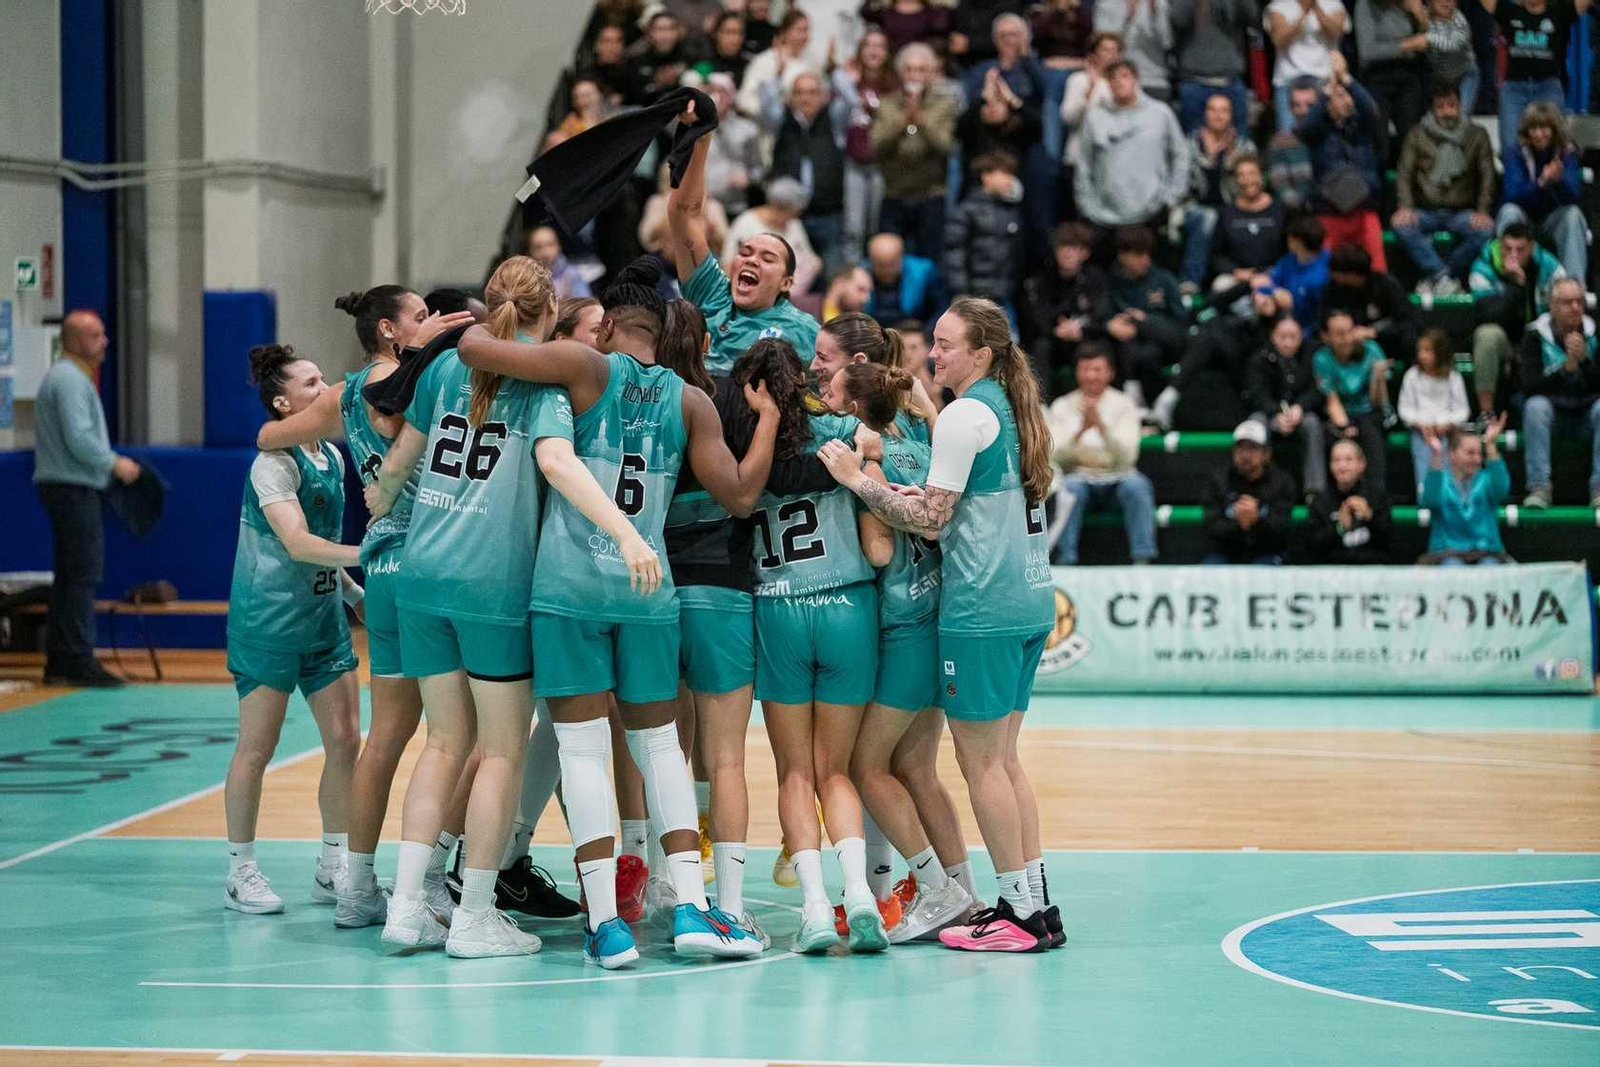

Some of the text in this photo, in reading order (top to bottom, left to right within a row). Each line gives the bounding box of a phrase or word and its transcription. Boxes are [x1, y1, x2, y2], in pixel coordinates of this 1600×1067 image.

[428, 411, 508, 482] 26
[614, 452, 647, 518] 6
[752, 496, 827, 569] 12
[1107, 593, 1220, 629] CAB
[1247, 589, 1568, 630] ESTEPONA
